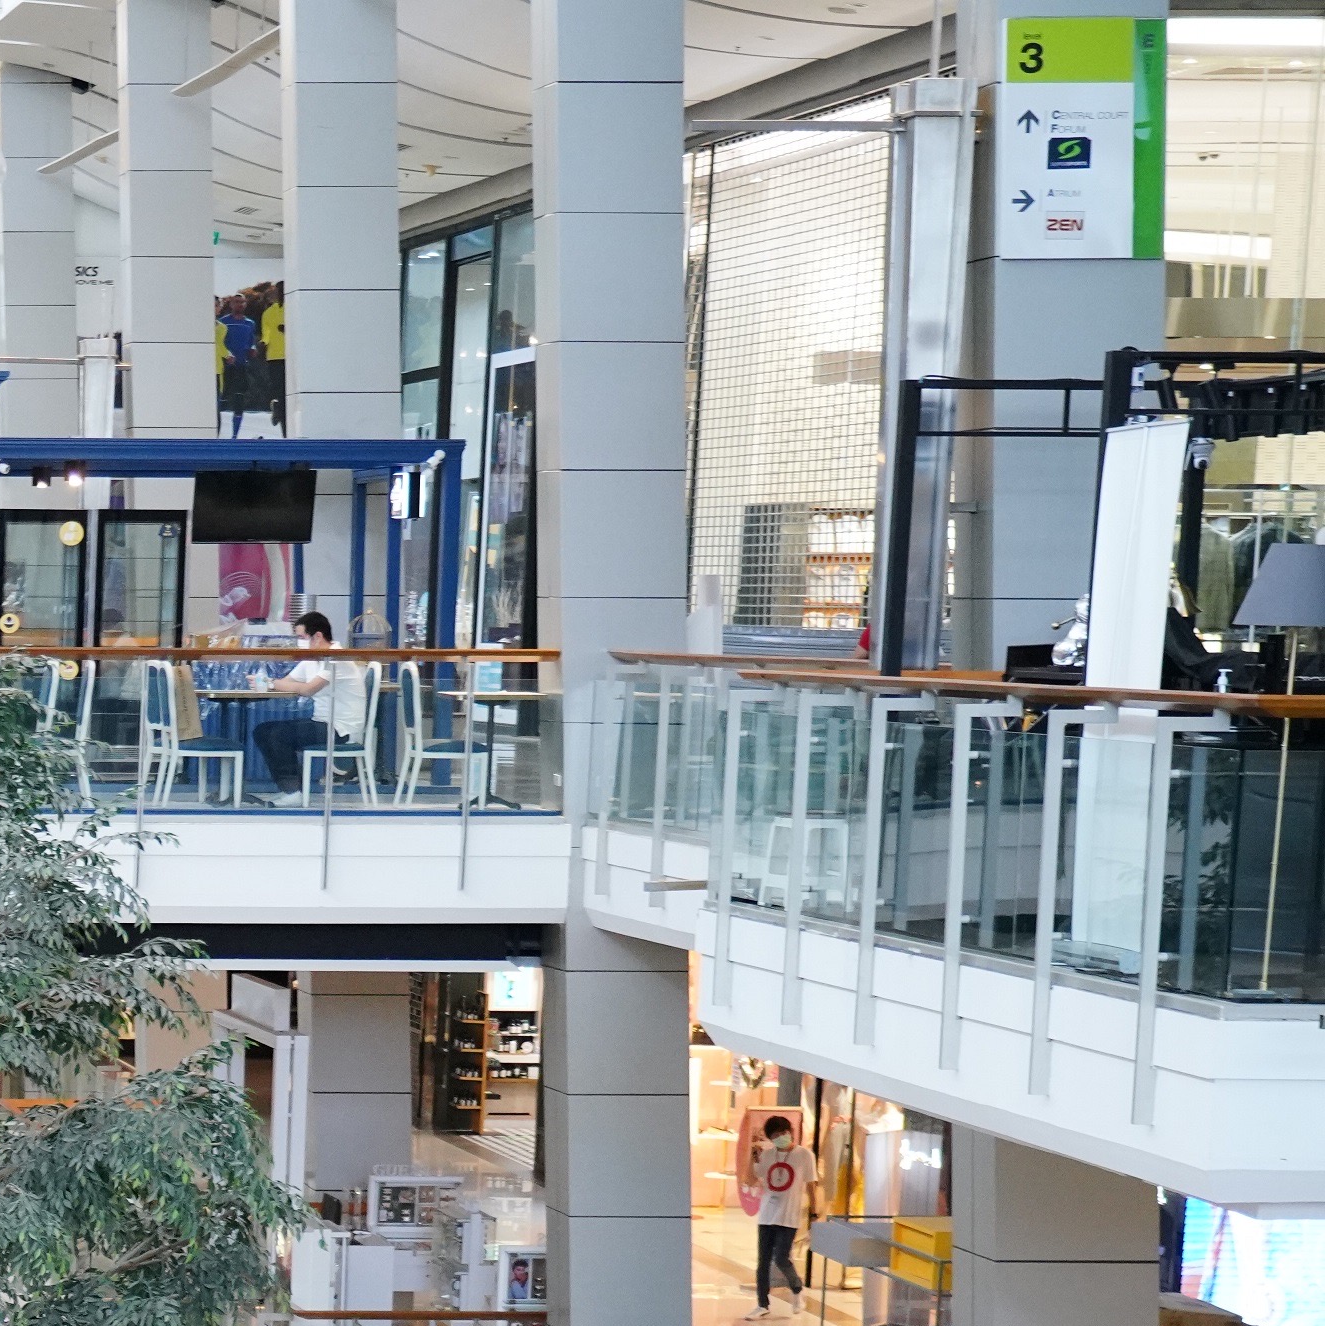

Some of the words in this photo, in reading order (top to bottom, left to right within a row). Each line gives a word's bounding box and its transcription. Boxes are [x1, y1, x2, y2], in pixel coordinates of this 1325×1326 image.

[1019, 43, 1044, 73] 3
[1046, 218, 1084, 231] ZEN
[75, 266, 99, 277] SICS
